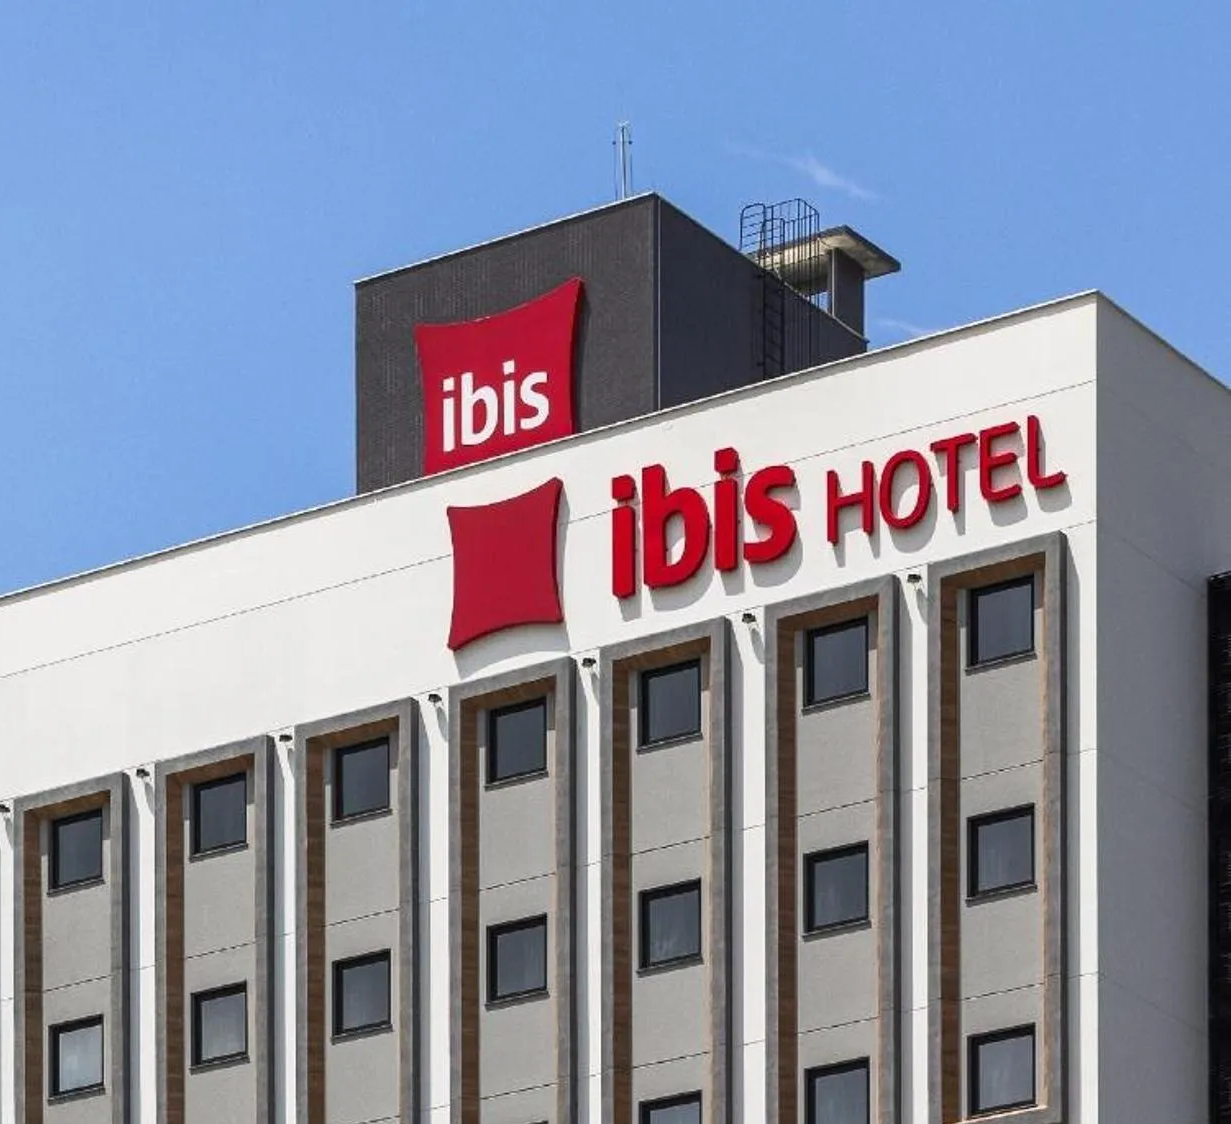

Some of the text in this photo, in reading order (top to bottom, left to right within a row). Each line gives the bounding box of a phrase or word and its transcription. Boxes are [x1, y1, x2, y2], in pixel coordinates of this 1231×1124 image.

[442, 359, 550, 453] ibis
[611, 415, 1067, 599] ibis HOTEL
